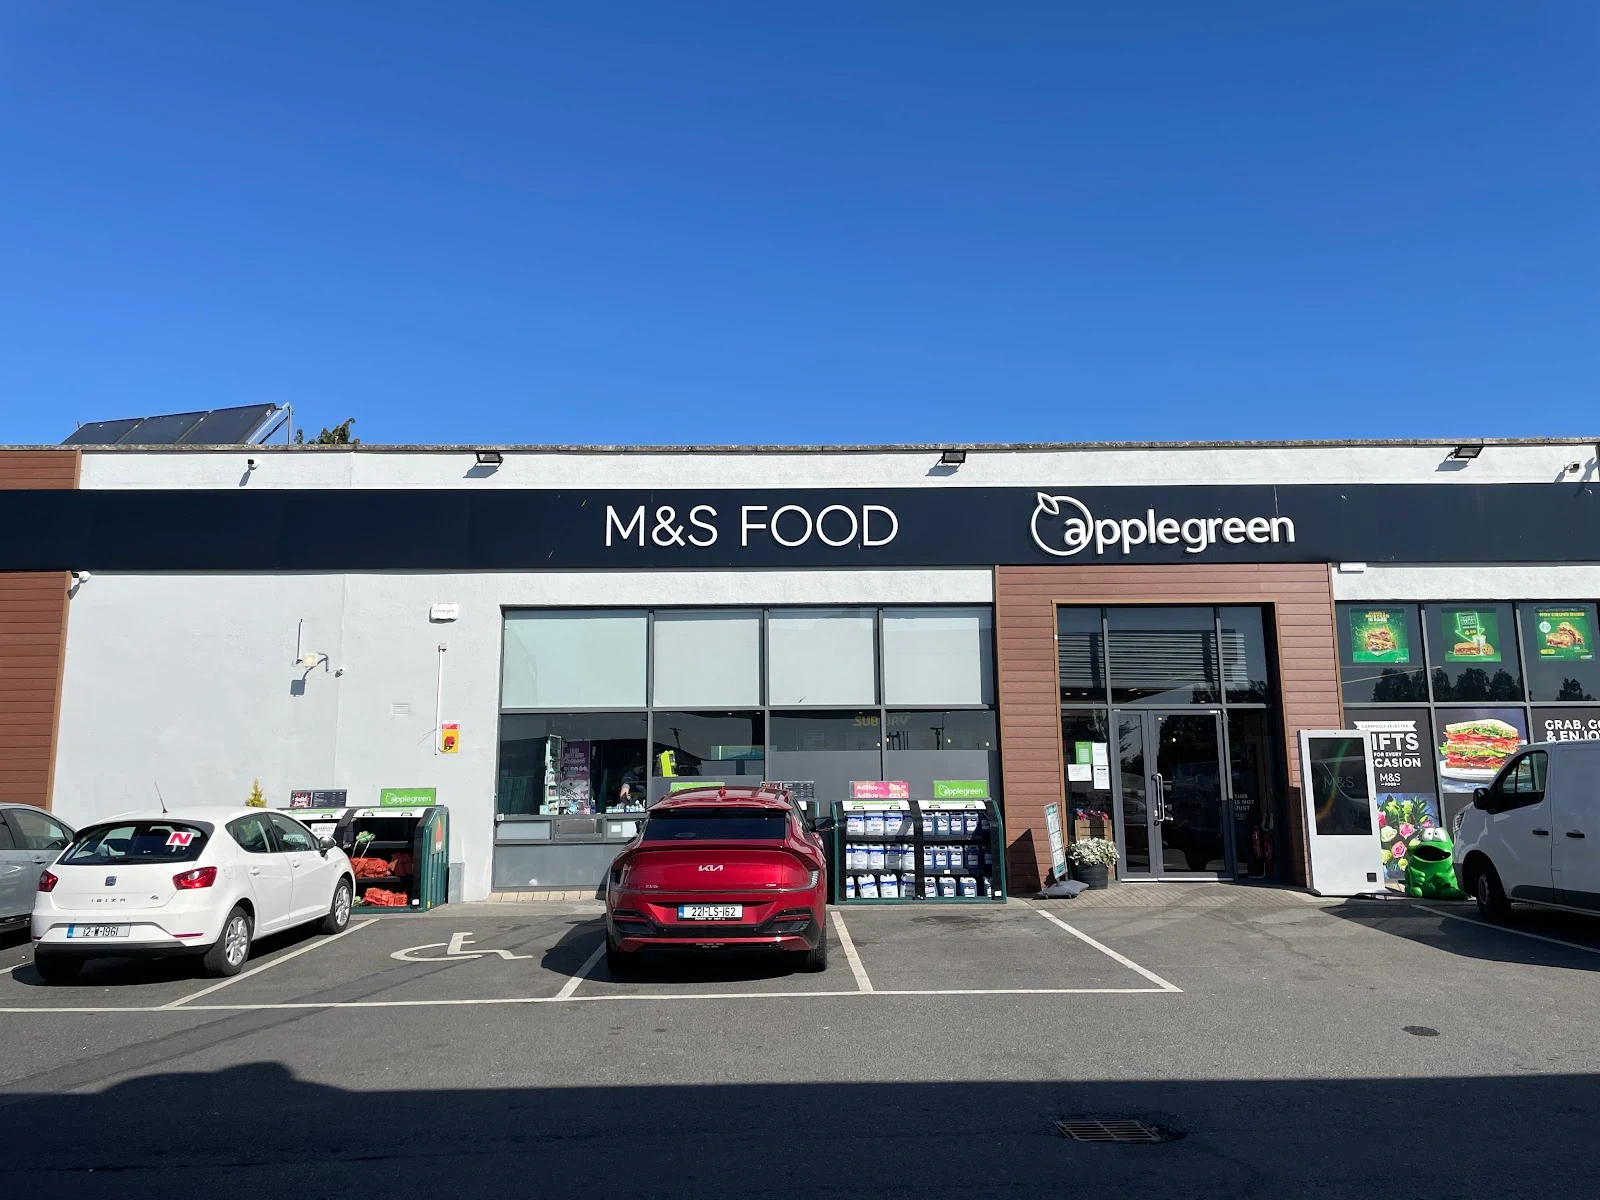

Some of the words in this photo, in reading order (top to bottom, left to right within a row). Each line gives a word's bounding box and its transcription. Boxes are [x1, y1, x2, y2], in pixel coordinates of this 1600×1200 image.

[605, 505, 719, 547] M&S
[741, 504, 899, 547] FOOD
[1064, 508, 1296, 555] applegreen
[1545, 719, 1586, 731] GRAB,
[1588, 719, 1600, 730] G
[1371, 733, 1419, 751] IFTS
[1546, 730, 1557, 742] &
[1560, 730, 1600, 741] ENJO
[1371, 757, 1421, 767] CASION
[1324, 776, 1355, 788] M&S
[1380, 773, 1401, 782] M&S
[943, 788, 983, 796] applegreen
[390, 797, 431, 805] applegreen
[169, 832, 192, 845] N
[698, 864, 724, 872] KIA
[691, 906, 736, 917] 221-LS-162
